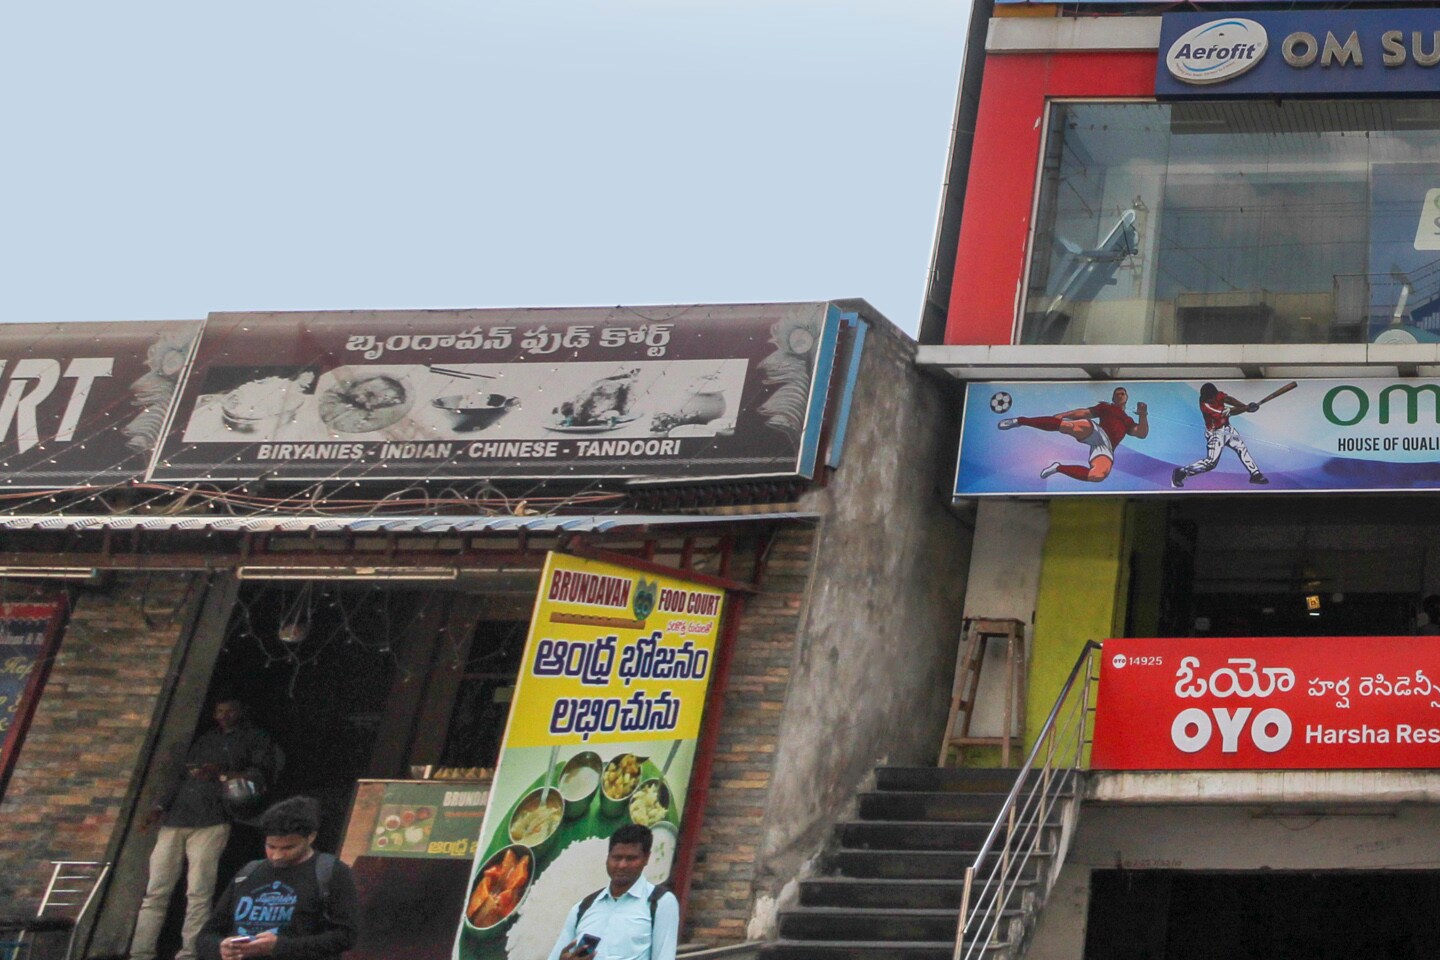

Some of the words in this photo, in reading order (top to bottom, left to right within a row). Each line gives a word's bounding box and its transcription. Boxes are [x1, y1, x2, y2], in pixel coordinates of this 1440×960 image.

[1174, 43, 1256, 60] Aerofit
[1282, 30, 1364, 68] OM
[345, 326, 517, 360] బృందావన్
[0, 357, 114, 454] RT
[257, 443, 364, 460] BIRYANIES
[380, 443, 452, 459] INDIAN
[469, 441, 558, 458] CHINESE
[577, 440, 681, 457] TANDOORI
[1338, 437, 1379, 451] HOUSE
[1383, 437, 1399, 450] OF
[549, 570, 632, 607] BRUNDAVAN
[658, 589, 686, 612] FOOD
[687, 592, 721, 615] COURT
[619, 632, 709, 685] భోజనం
[1129, 656, 1163, 666] 14925
[1175, 656, 1295, 698] ఓయో
[1308, 677, 1350, 708] హర్ష
[550, 692, 680, 741] లభించును
[1171, 708, 1292, 753] OYO
[1305, 724, 1390, 744] Harsha
[443, 791, 490, 807] BRUNDA
